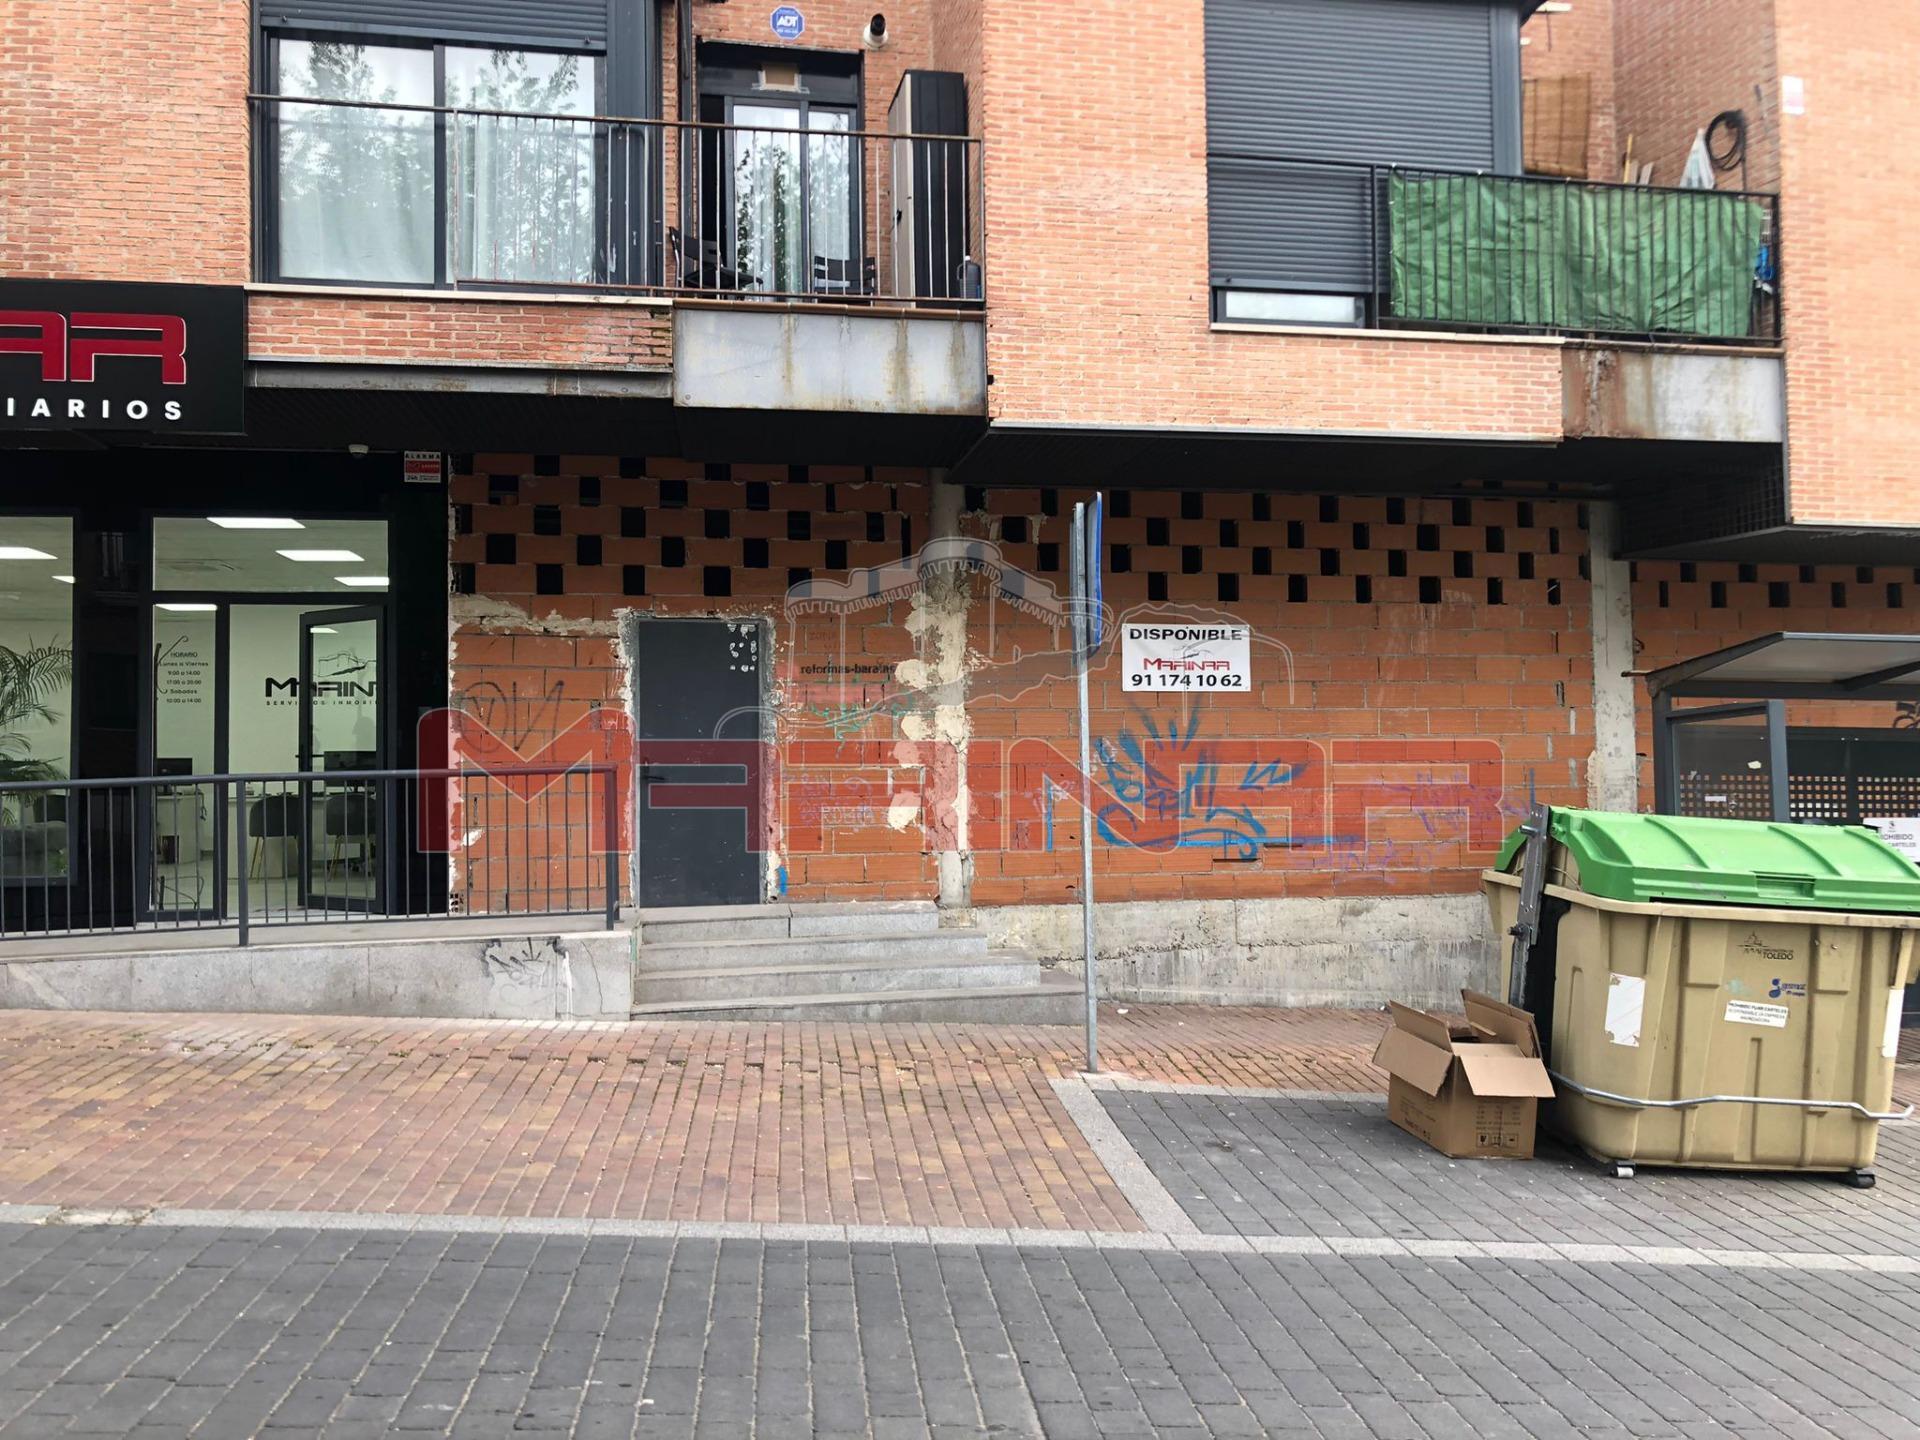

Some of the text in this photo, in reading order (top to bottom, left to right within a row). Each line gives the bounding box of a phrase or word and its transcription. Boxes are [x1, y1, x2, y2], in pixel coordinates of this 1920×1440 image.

[777, 15, 799, 27] ADT
[7, 397, 182, 420] IARIOS
[1130, 628, 1242, 641] DISPONIBLE
[1131, 674, 1152, 687] 91
[1159, 674, 1191, 687] 174
[1220, 674, 1242, 687] 62
[1763, 952, 1794, 960] TOLEDO
